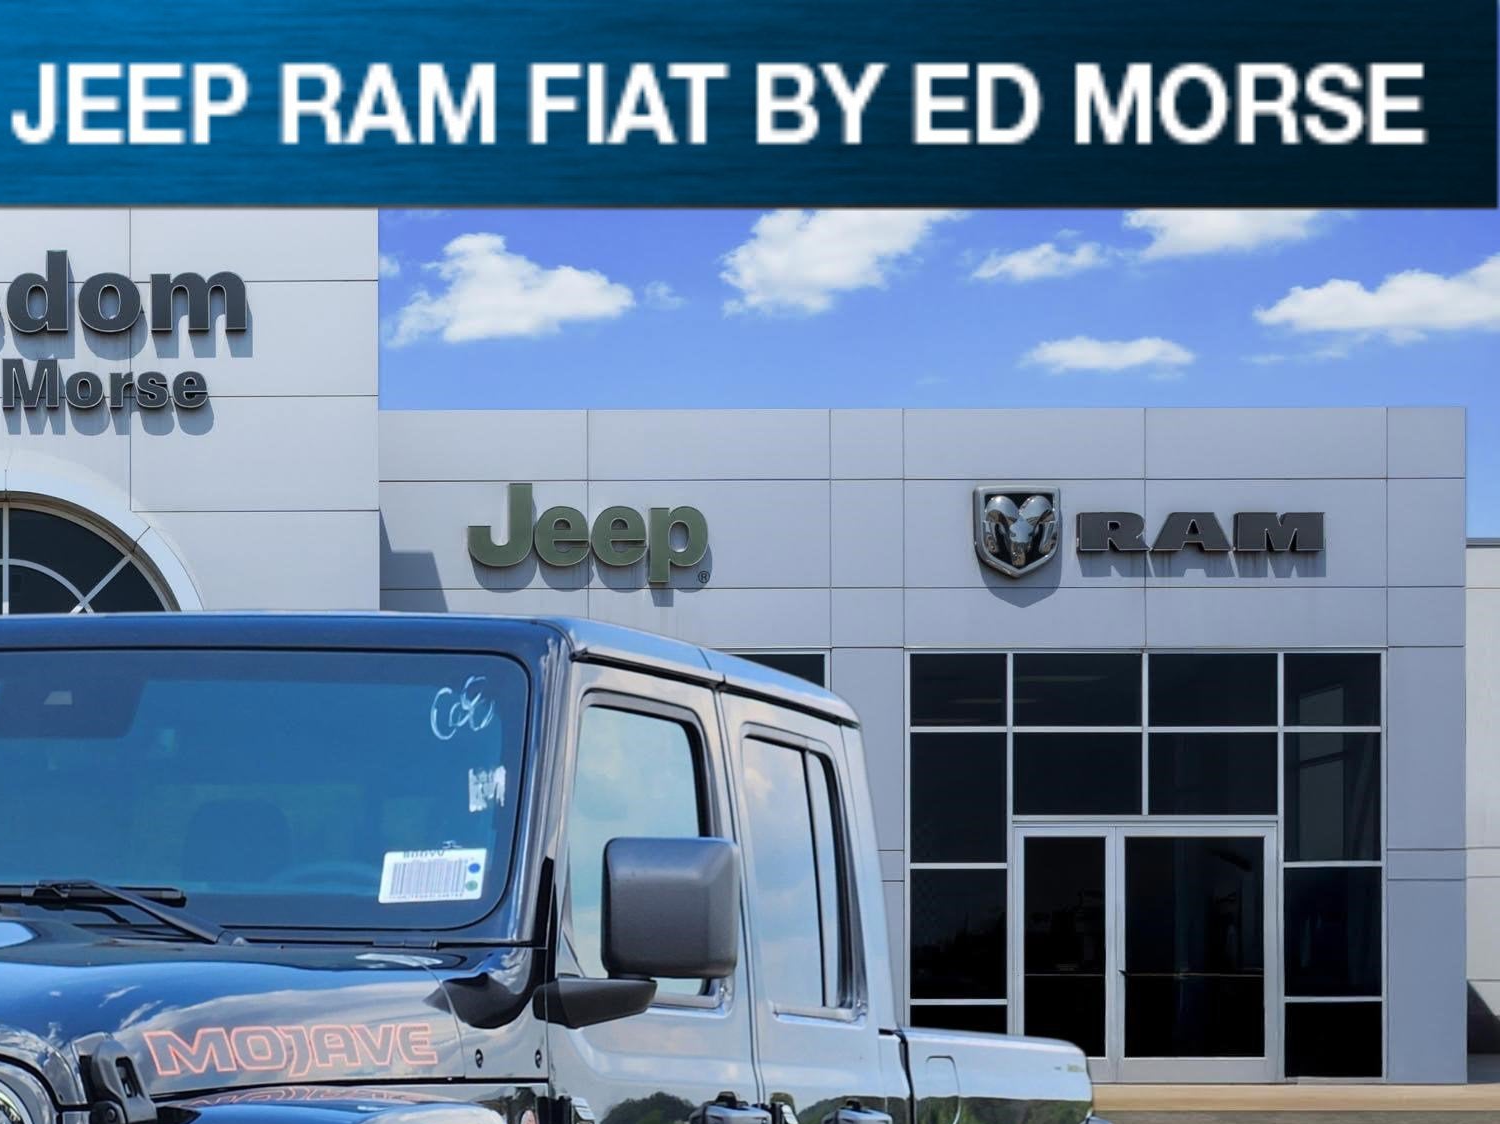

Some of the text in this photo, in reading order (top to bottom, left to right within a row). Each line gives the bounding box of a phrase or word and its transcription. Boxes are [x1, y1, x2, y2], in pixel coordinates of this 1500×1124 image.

[3, 359, 208, 408] Morse
[468, 483, 708, 583] Jeep
[1076, 512, 1326, 553] RAM
[142, 1023, 438, 1078] MOJAVE
